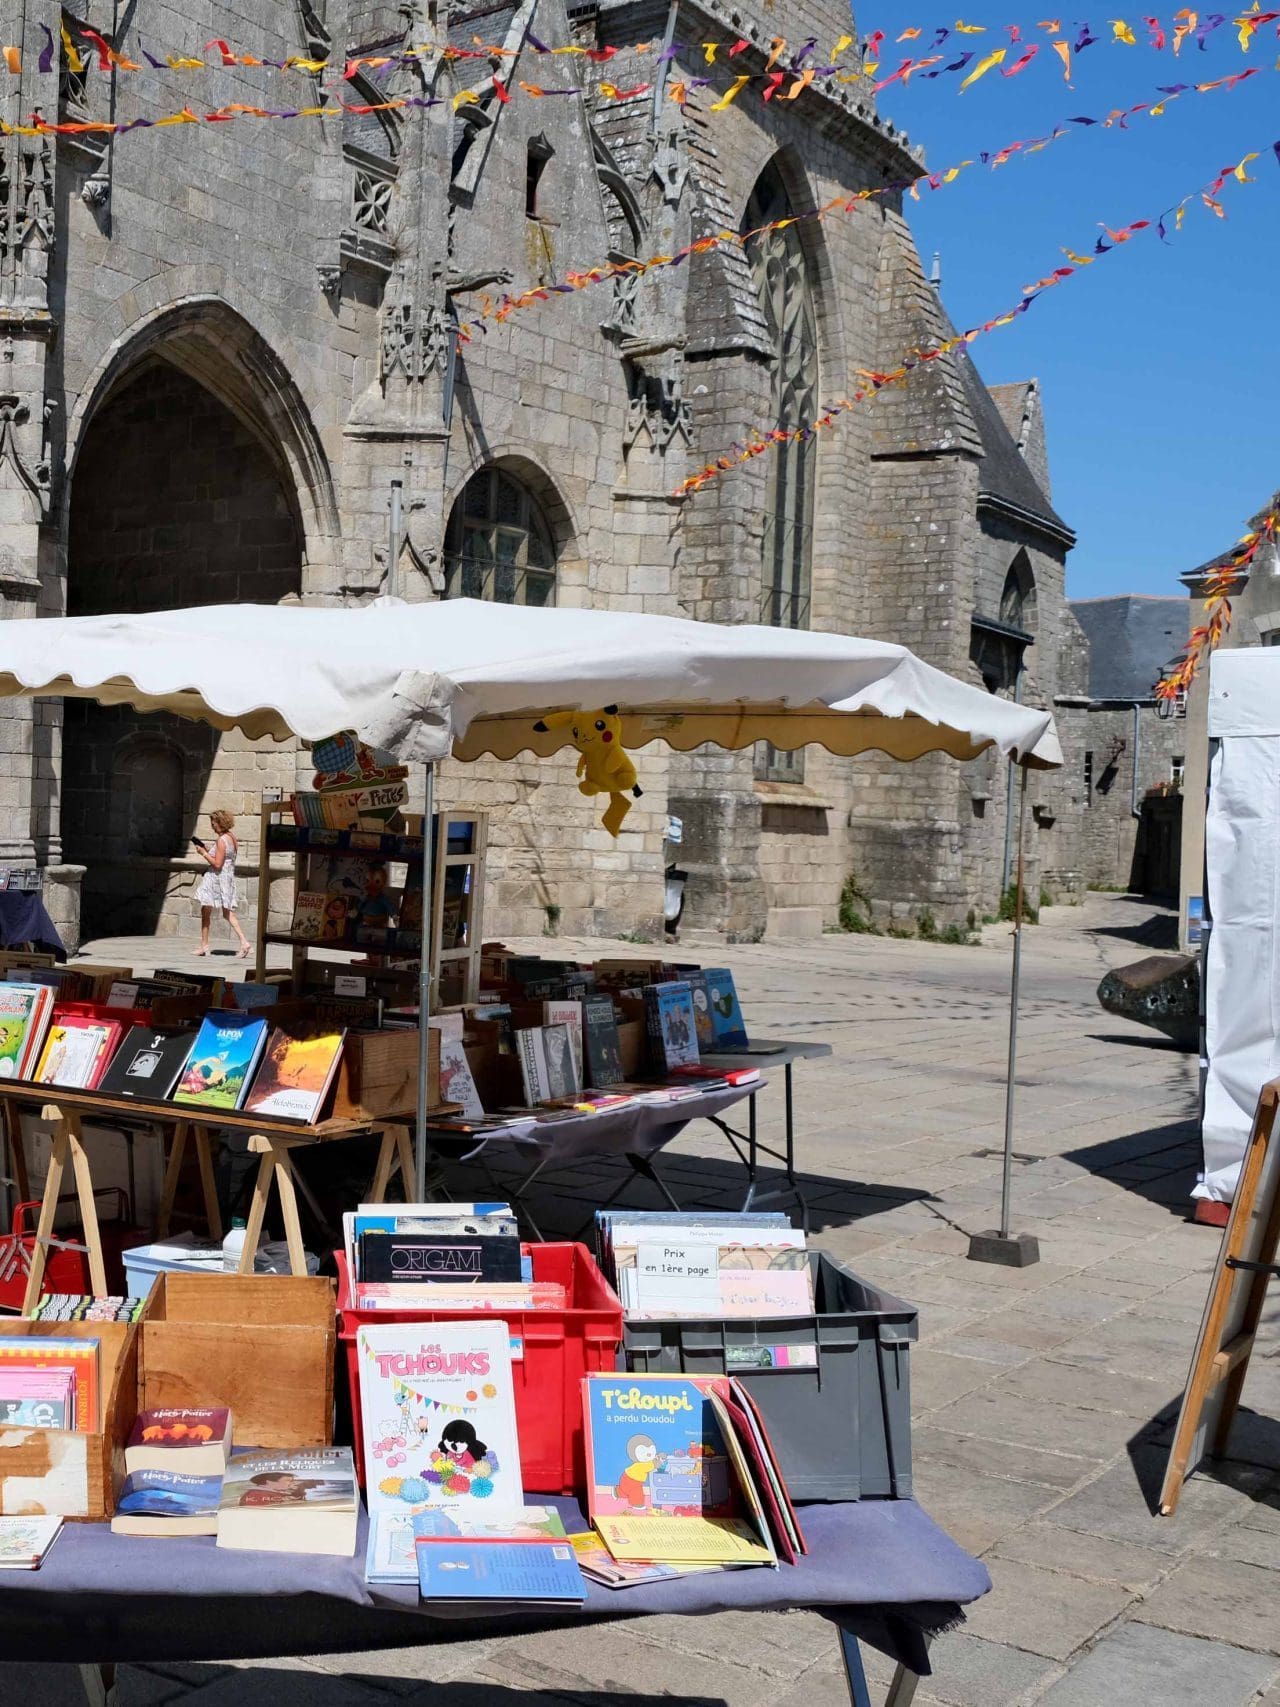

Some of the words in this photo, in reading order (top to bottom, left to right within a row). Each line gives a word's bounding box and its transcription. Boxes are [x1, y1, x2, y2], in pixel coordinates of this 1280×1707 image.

[216, 1029, 244, 1039] JAPON
[271, 1098, 312, 1111] Aldobrando
[390, 1249, 482, 1271] ORIGAMI
[664, 1249, 686, 1258] Prix
[645, 1265, 657, 1273] en
[662, 1264, 685, 1273] 1ère
[687, 1266, 710, 1276] page
[375, 1352, 491, 1378] TCHOUKS
[78, 1381, 88, 1430] JOURNAL
[601, 1387, 694, 1414] T'choupi
[152, 1410, 182, 1418] Harry
[182, 1409, 214, 1420] Potter
[614, 1414, 639, 1424] perdu
[641, 1414, 675, 1424] Doudou
[142, 1471, 172, 1482] Harry
[172, 1474, 207, 1485] Potter
